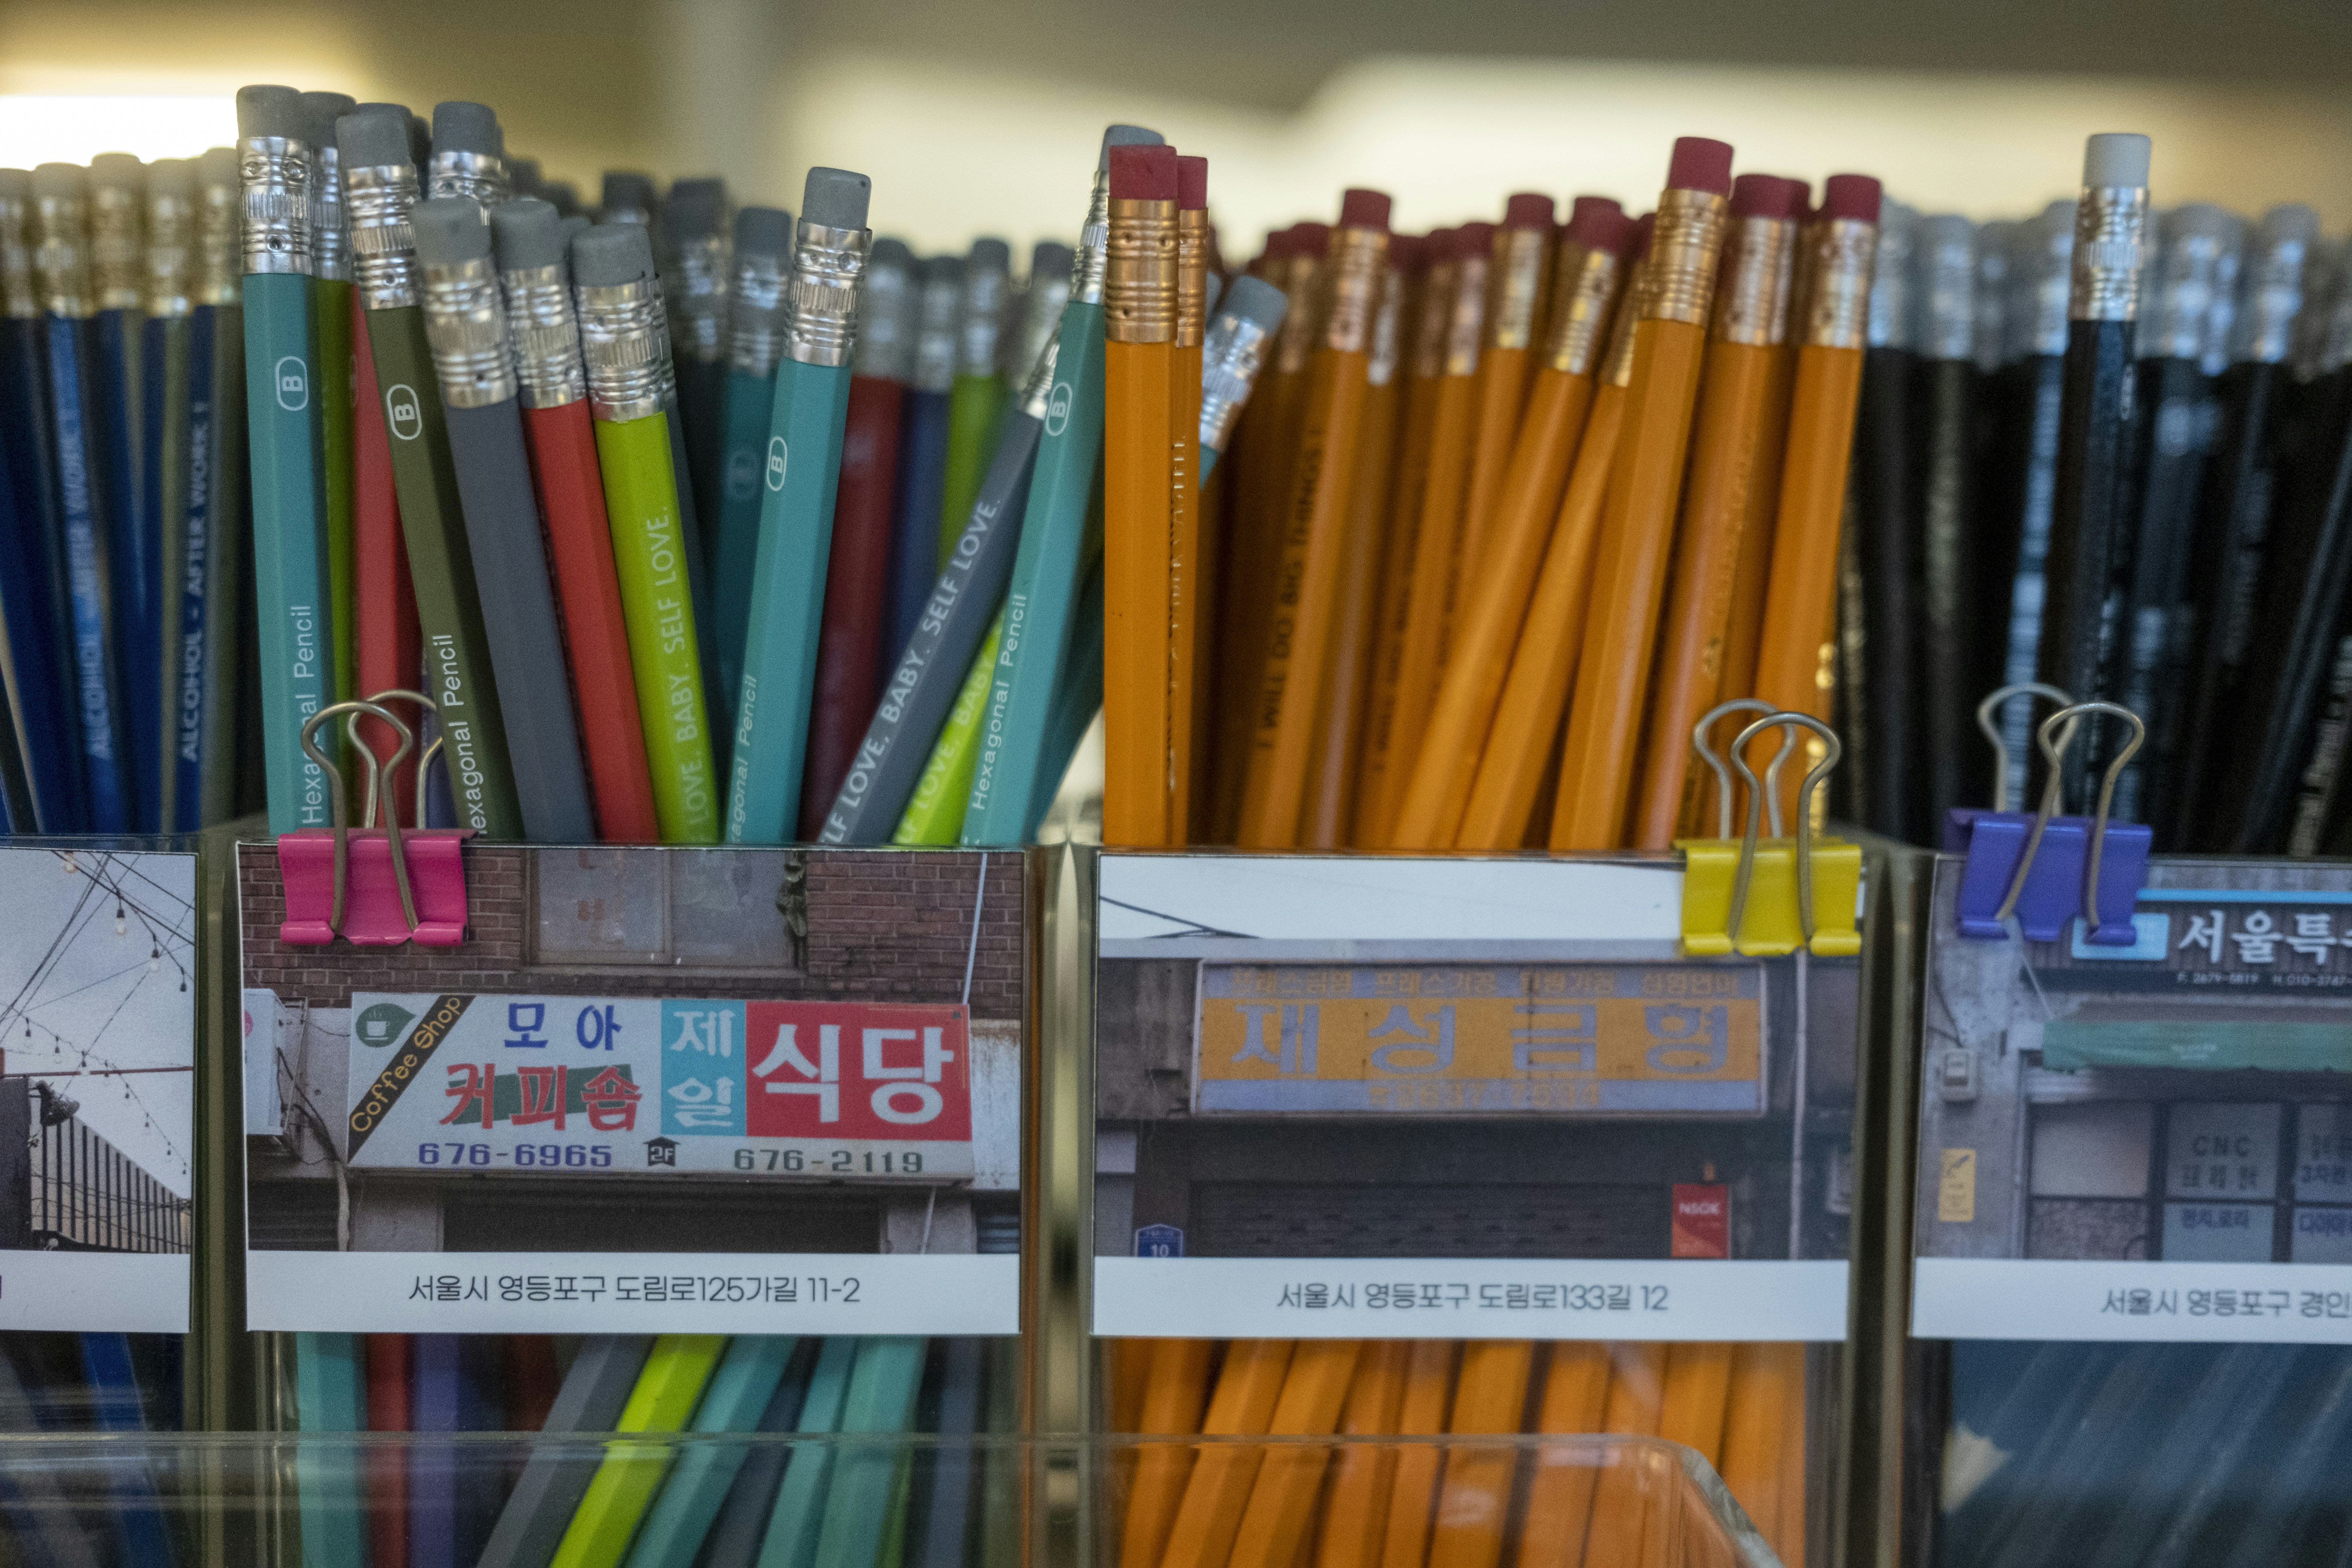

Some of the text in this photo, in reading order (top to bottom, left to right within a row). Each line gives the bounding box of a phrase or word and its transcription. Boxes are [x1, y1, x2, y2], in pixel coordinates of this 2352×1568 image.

[282, 376, 303, 391] B
[394, 403, 415, 421] B
[1051, 401, 1066, 418] B
[770, 455, 784, 474] B
[647, 505, 676, 586] LOVE.
[291, 605, 314, 678] Pencil
[657, 597, 684, 654] SELF
[840, 737, 890, 808] LOVE.
[880, 649, 930, 724] BABY.
[922, 576, 959, 636] SELF
[952, 499, 1001, 571] LOVE.
[181, 629, 202, 763] ALCOHOL
[739, 674, 757, 746] Pencil
[972, 681, 1009, 810] Hexagonal
[1000, 594, 1027, 666] Pencil
[432, 635, 487, 835] exagonal Pencil
[2179, 909, 2352, 966] 서울특
[504, 1003, 622, 1050] 모아
[351, 996, 461, 1132] Coffee Shop
[667, 1009, 736, 1127] 제일
[752, 1024, 954, 1125] 식당
[439, 1063, 642, 1131] 커피숍
[419, 1143, 612, 1168] 676-6965
[650, 1146, 674, 1161] 2F
[734, 1149, 923, 1173] 676-2119
[408, 1275, 861, 1303] 서울시 영등포구 도림로125가길 11-2
[1276, 1282, 1669, 1311] 서울시 영등포구 도림로133길 12
[2101, 1288, 2178, 1316] 서울시
[2187, 1289, 2290, 1317] 영등포구
